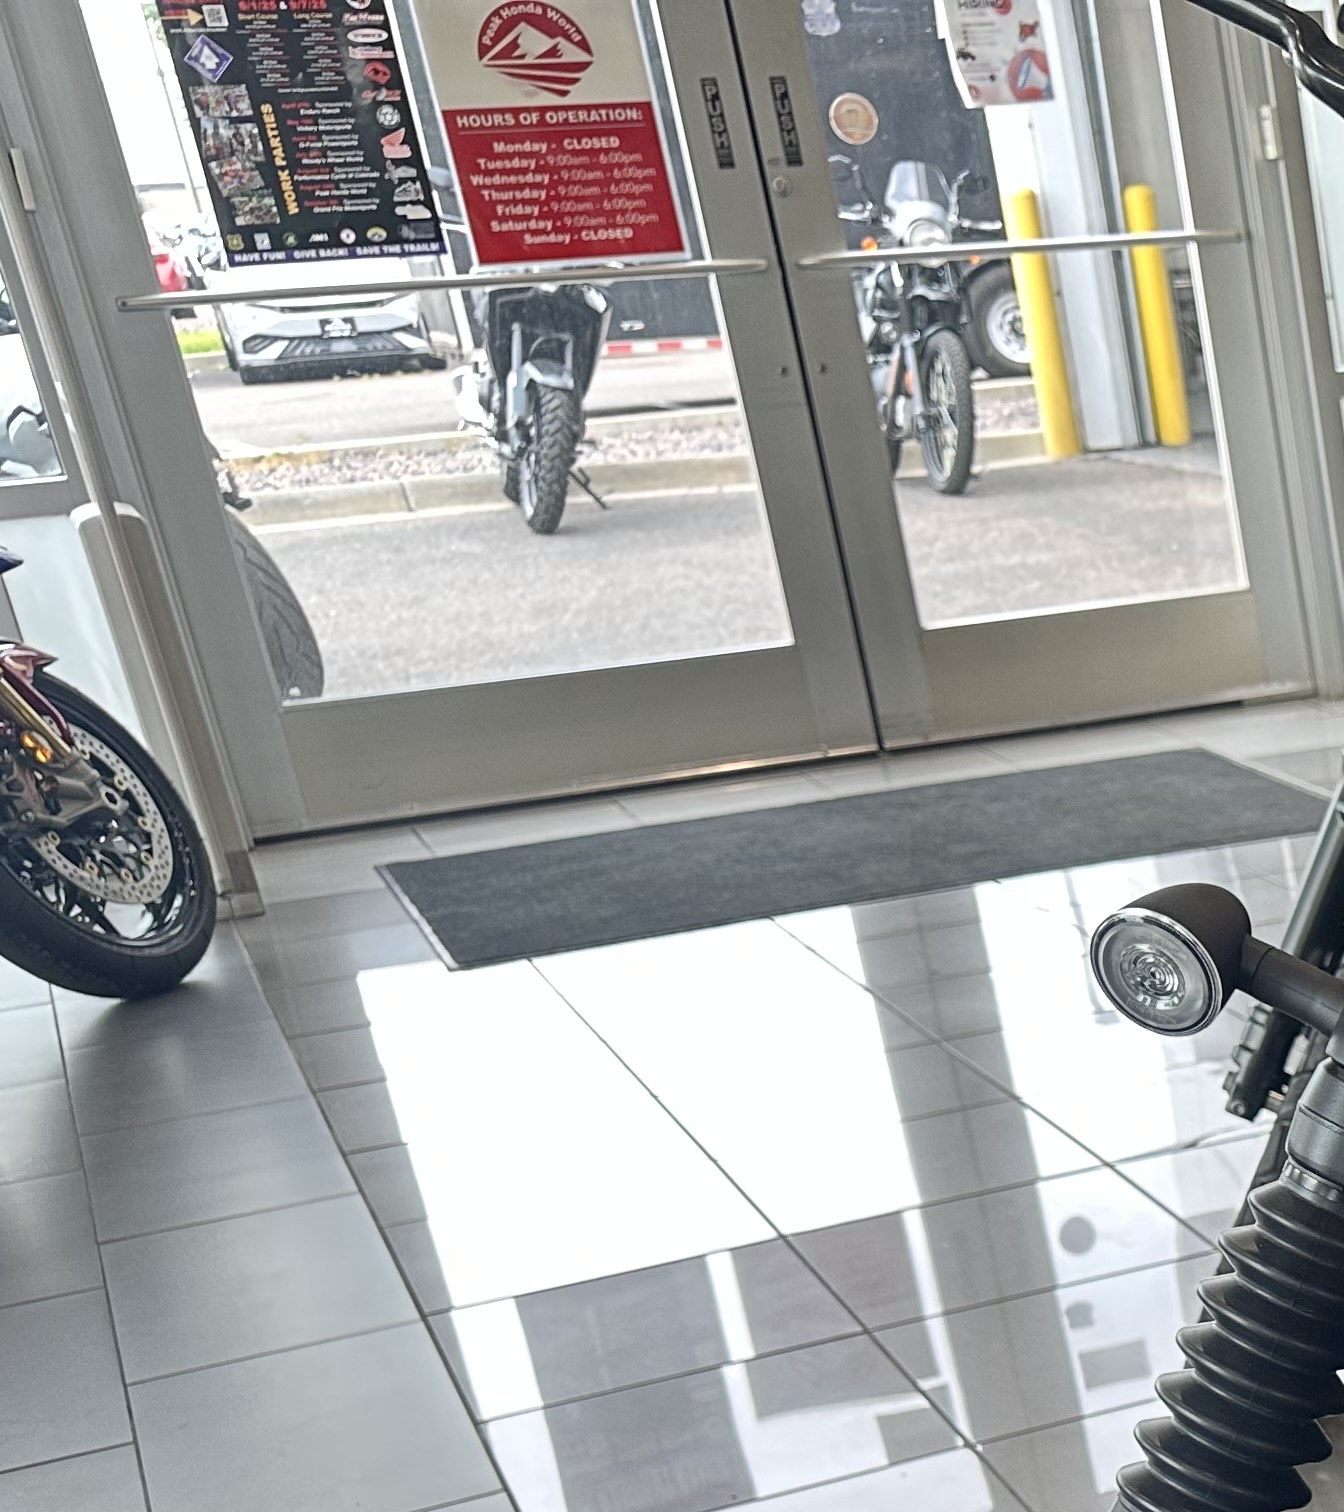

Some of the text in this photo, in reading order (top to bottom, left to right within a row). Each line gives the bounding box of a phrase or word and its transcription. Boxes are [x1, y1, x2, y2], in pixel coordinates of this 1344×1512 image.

[482, 3, 583, 46] Peak Honda World
[456, 108, 643, 128] HOURS OF OPERATION:
[704, 84, 729, 149] PUSH
[773, 83, 797, 146] PUSH
[260, 103, 287, 166] PARTIES
[492, 141, 547, 154] Monday
[562, 135, 620, 150] CLOSED
[477, 156, 536, 170] Tuesday
[470, 171, 550, 186] Wednesday
[278, 169, 299, 215] WORK
[481, 186, 547, 201] Thursday
[496, 202, 540, 217] Friday
[490, 217, 553, 232] Saturday
[523, 231, 571, 245] Sunday
[581, 227, 634, 241] CLOSED
[234, 251, 286, 263] HAVE FUN!
[293, 247, 349, 261] GIVE BACK!
[356, 243, 440, 257] SAVE THE TRAILS!
